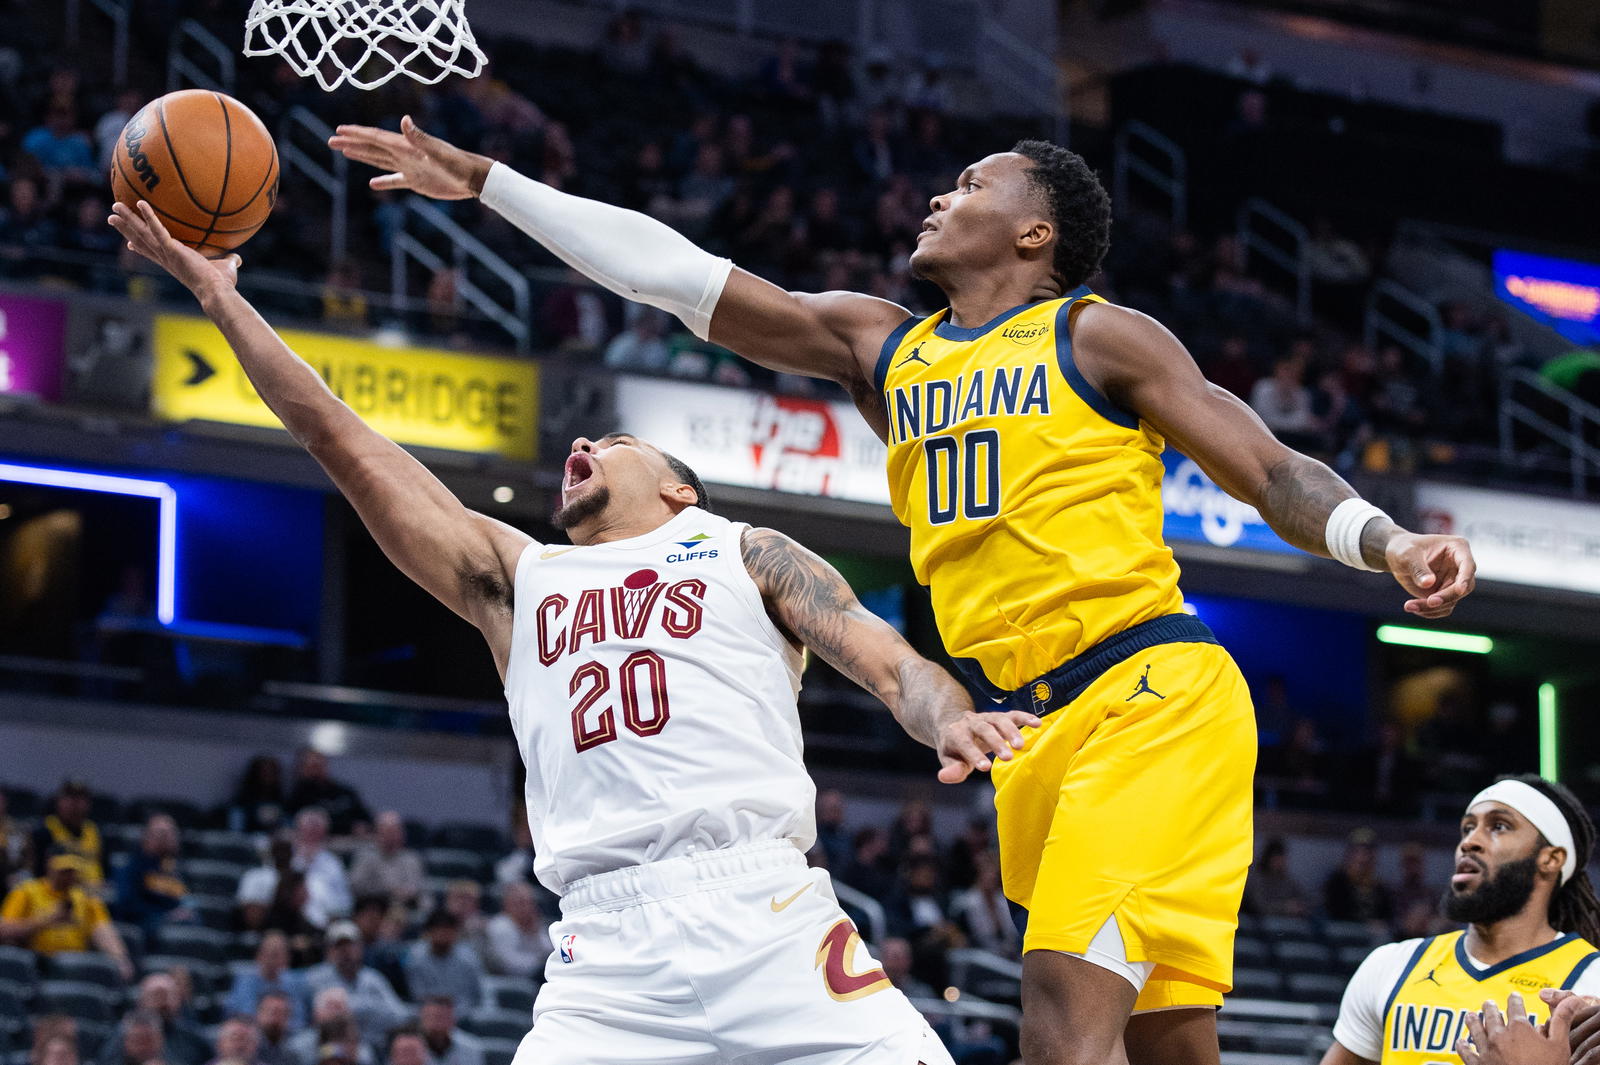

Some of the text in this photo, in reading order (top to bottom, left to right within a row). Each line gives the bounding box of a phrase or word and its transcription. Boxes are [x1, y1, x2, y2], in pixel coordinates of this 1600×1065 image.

[1001, 328, 1037, 338] LUCAS
[886, 363, 1051, 447] INDIANA
[923, 428, 1000, 526] 00
[666, 549, 719, 563] CLIFFS
[536, 575, 708, 667] CAVS
[569, 648, 671, 754] 20
